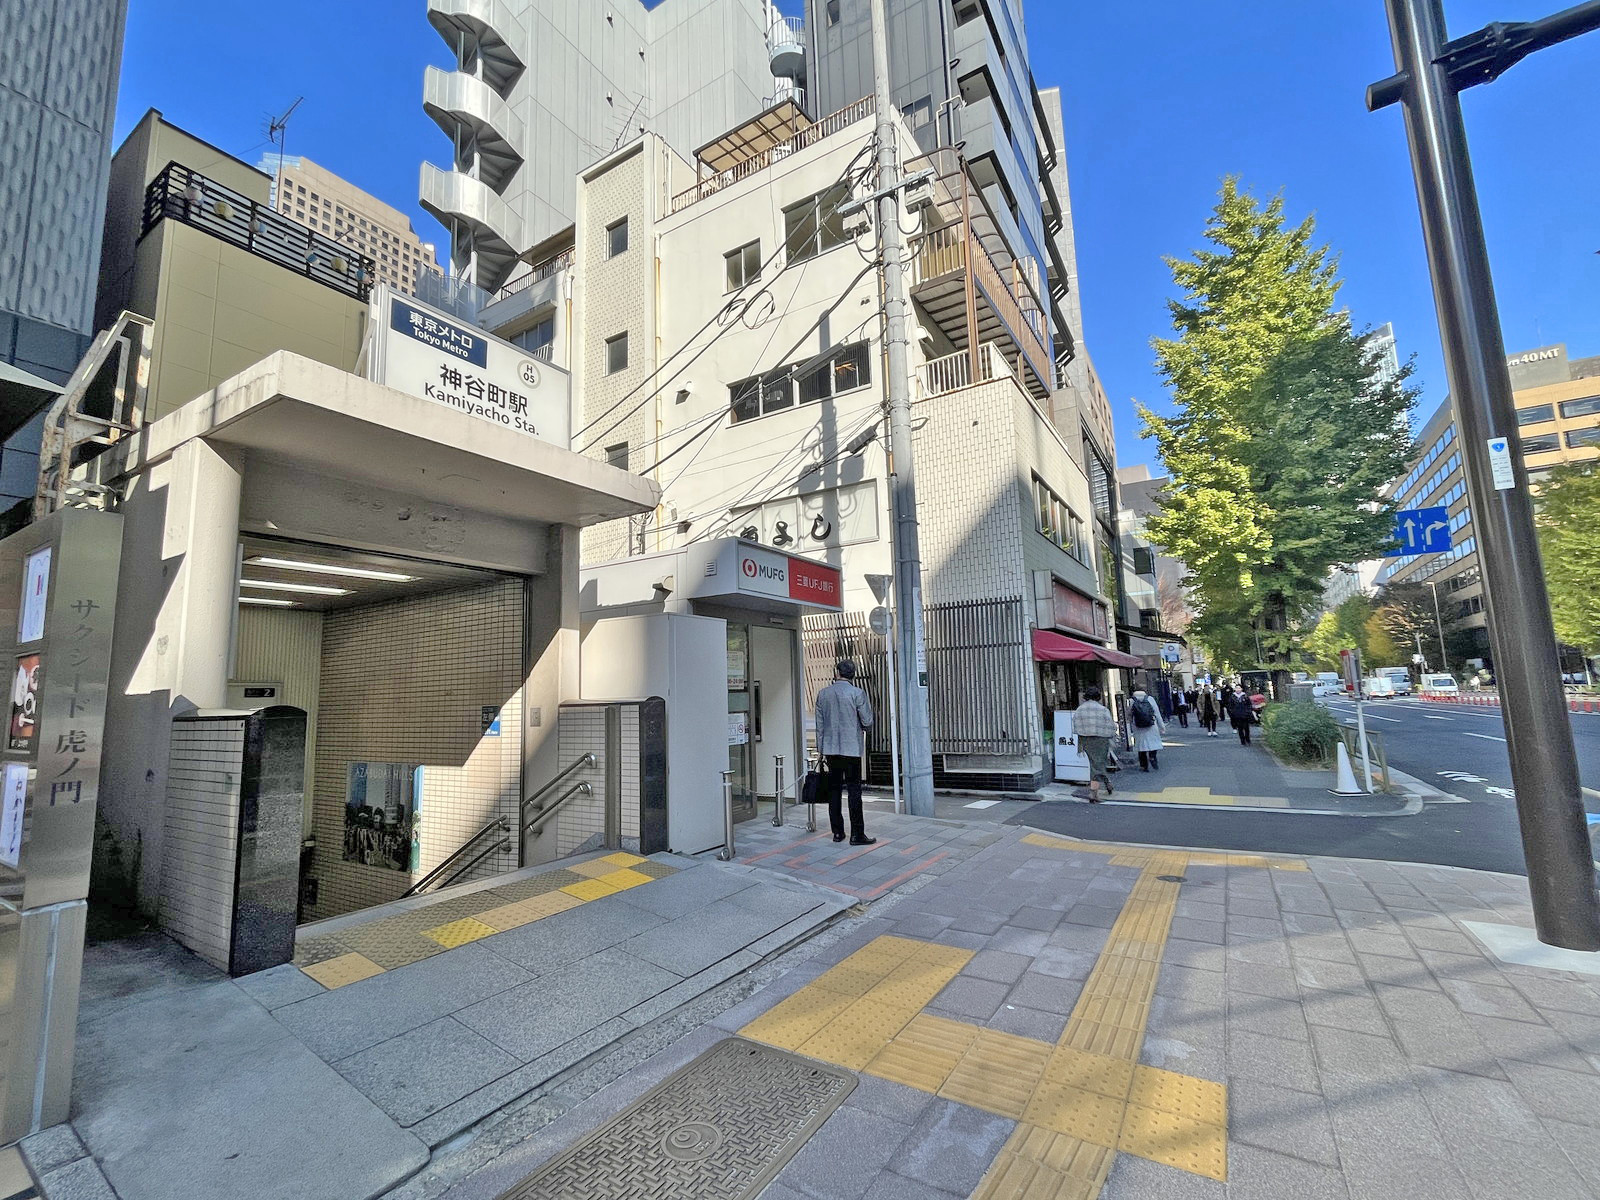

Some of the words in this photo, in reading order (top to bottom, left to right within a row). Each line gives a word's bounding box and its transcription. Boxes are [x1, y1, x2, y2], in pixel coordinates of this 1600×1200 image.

[409, 310, 472, 349] 東京メトロ
[413, 326, 440, 346] Tokyo
[442, 339, 468, 358] Metro
[523, 372, 535, 384] 05
[526, 364, 533, 374] H
[440, 363, 528, 417] 神谷町駅
[424, 382, 510, 425] Kamiyacho
[515, 416, 539, 436] Sta.
[759, 564, 785, 582] MUFG
